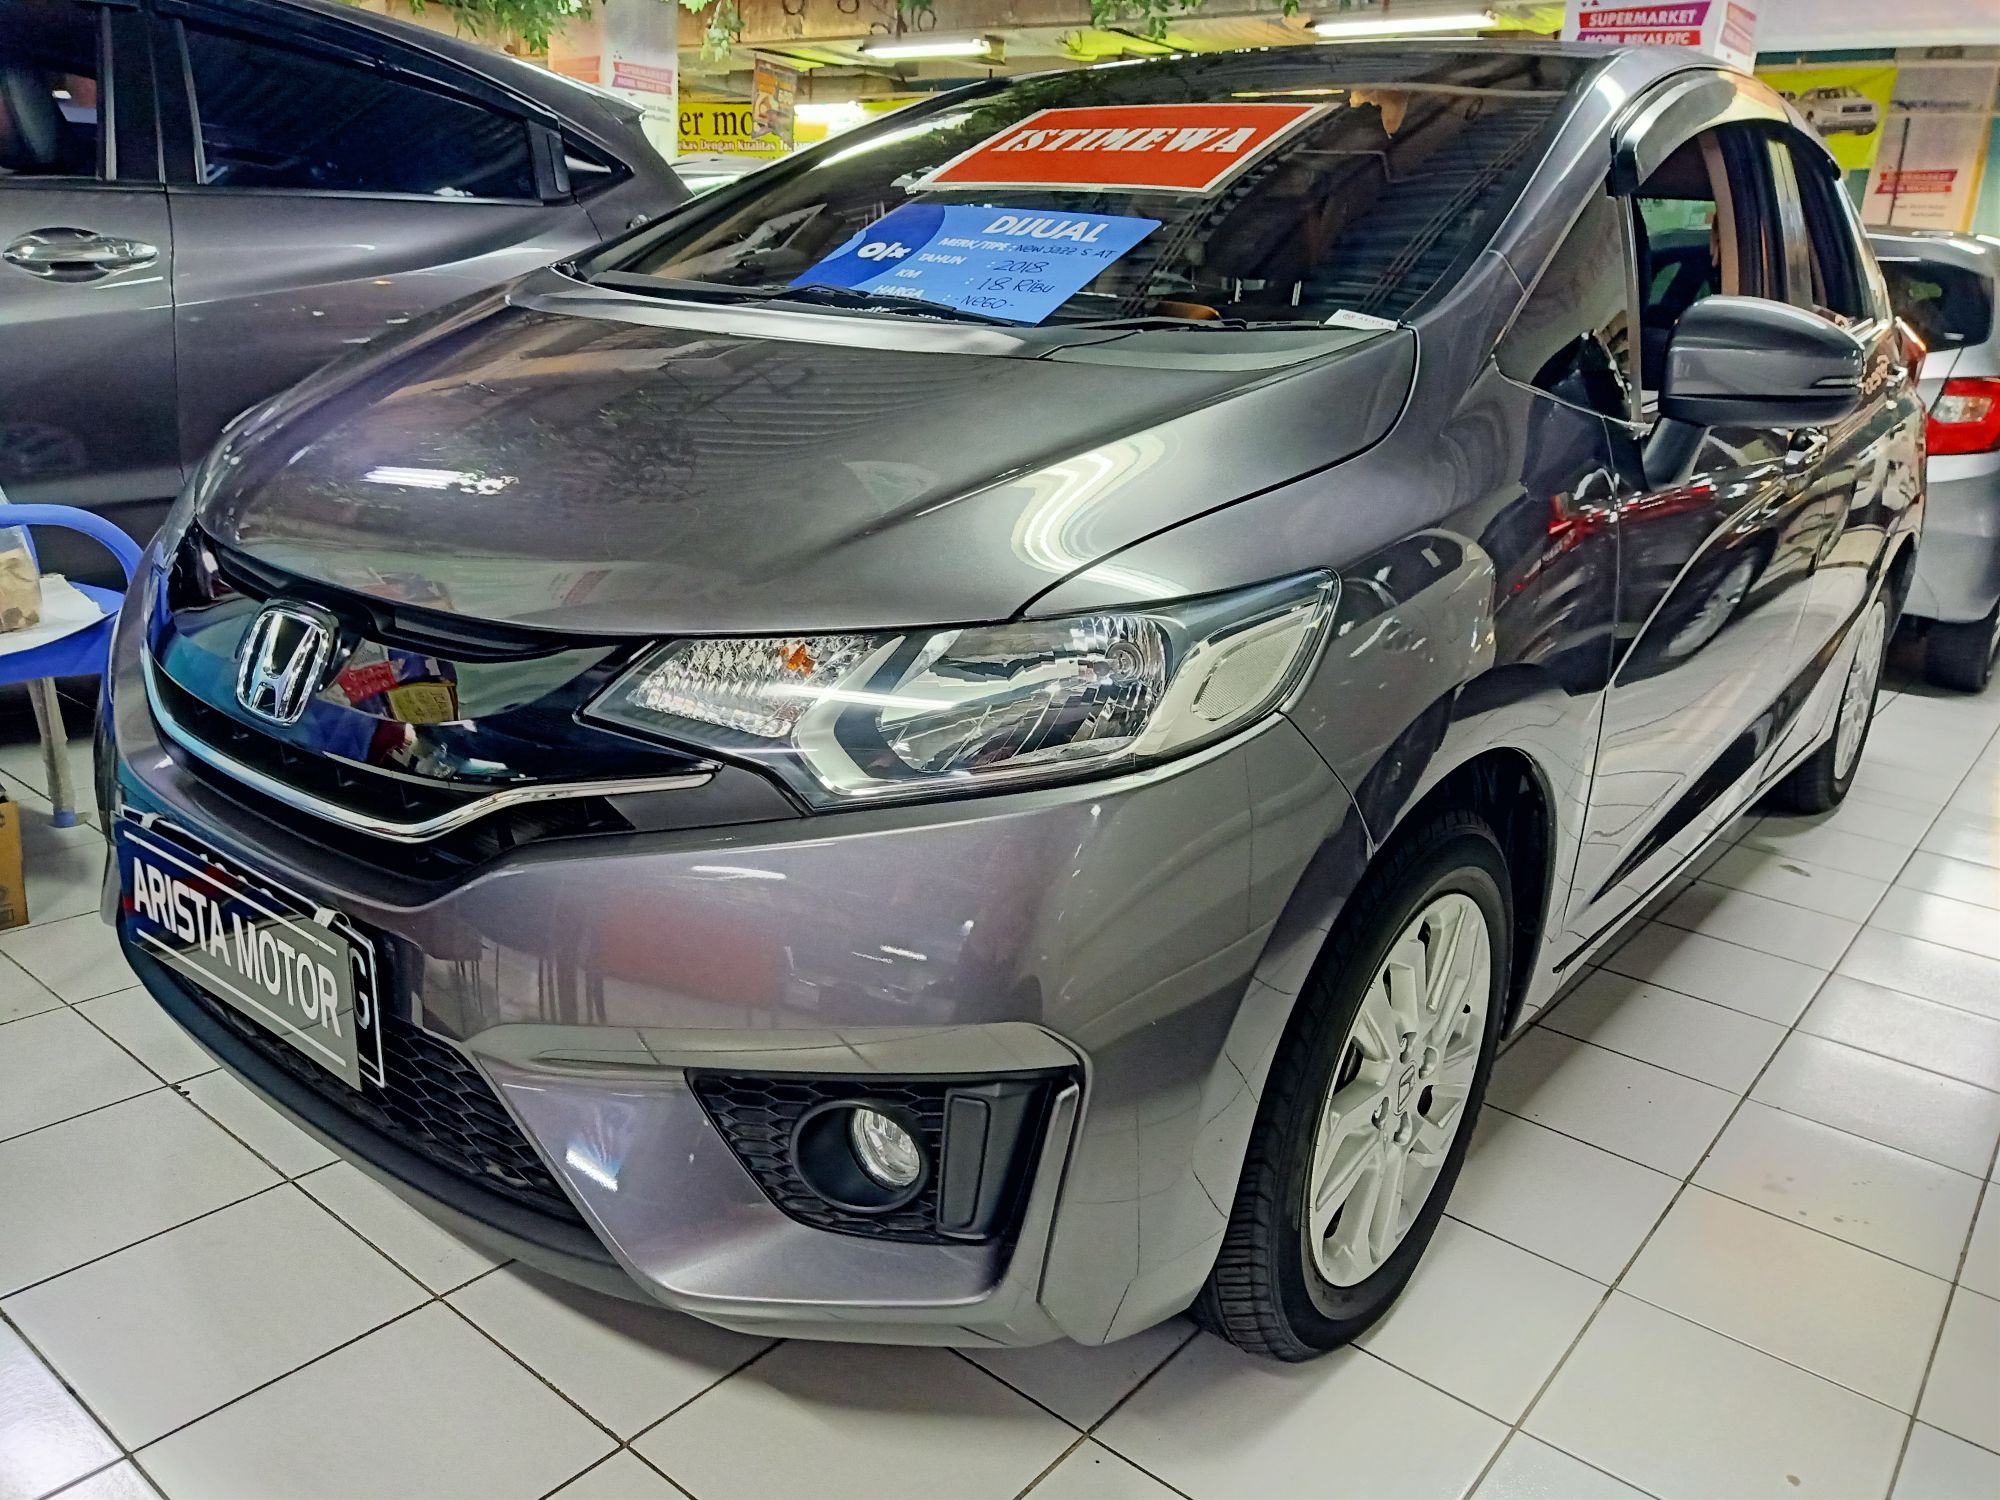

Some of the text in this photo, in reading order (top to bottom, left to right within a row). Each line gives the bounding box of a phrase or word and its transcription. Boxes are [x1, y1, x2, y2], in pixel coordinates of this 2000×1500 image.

[1588, 9, 1697, 27] SUPERMARKET
[1664, 32, 1690, 45] DTC
[700, 140, 735, 153] Dengan
[737, 140, 775, 152] Kualitas
[990, 127, 1258, 153] ISTIMEWA
[982, 215, 1109, 243] DIJUAL
[918, 253, 967, 265] TAHUN
[1095, 250, 1116, 259] AT
[895, 269, 923, 278] KM
[993, 260, 1049, 274] 2018
[873, 285, 924, 298] HARGA
[133, 856, 342, 1038] ARISTA MOTOR
